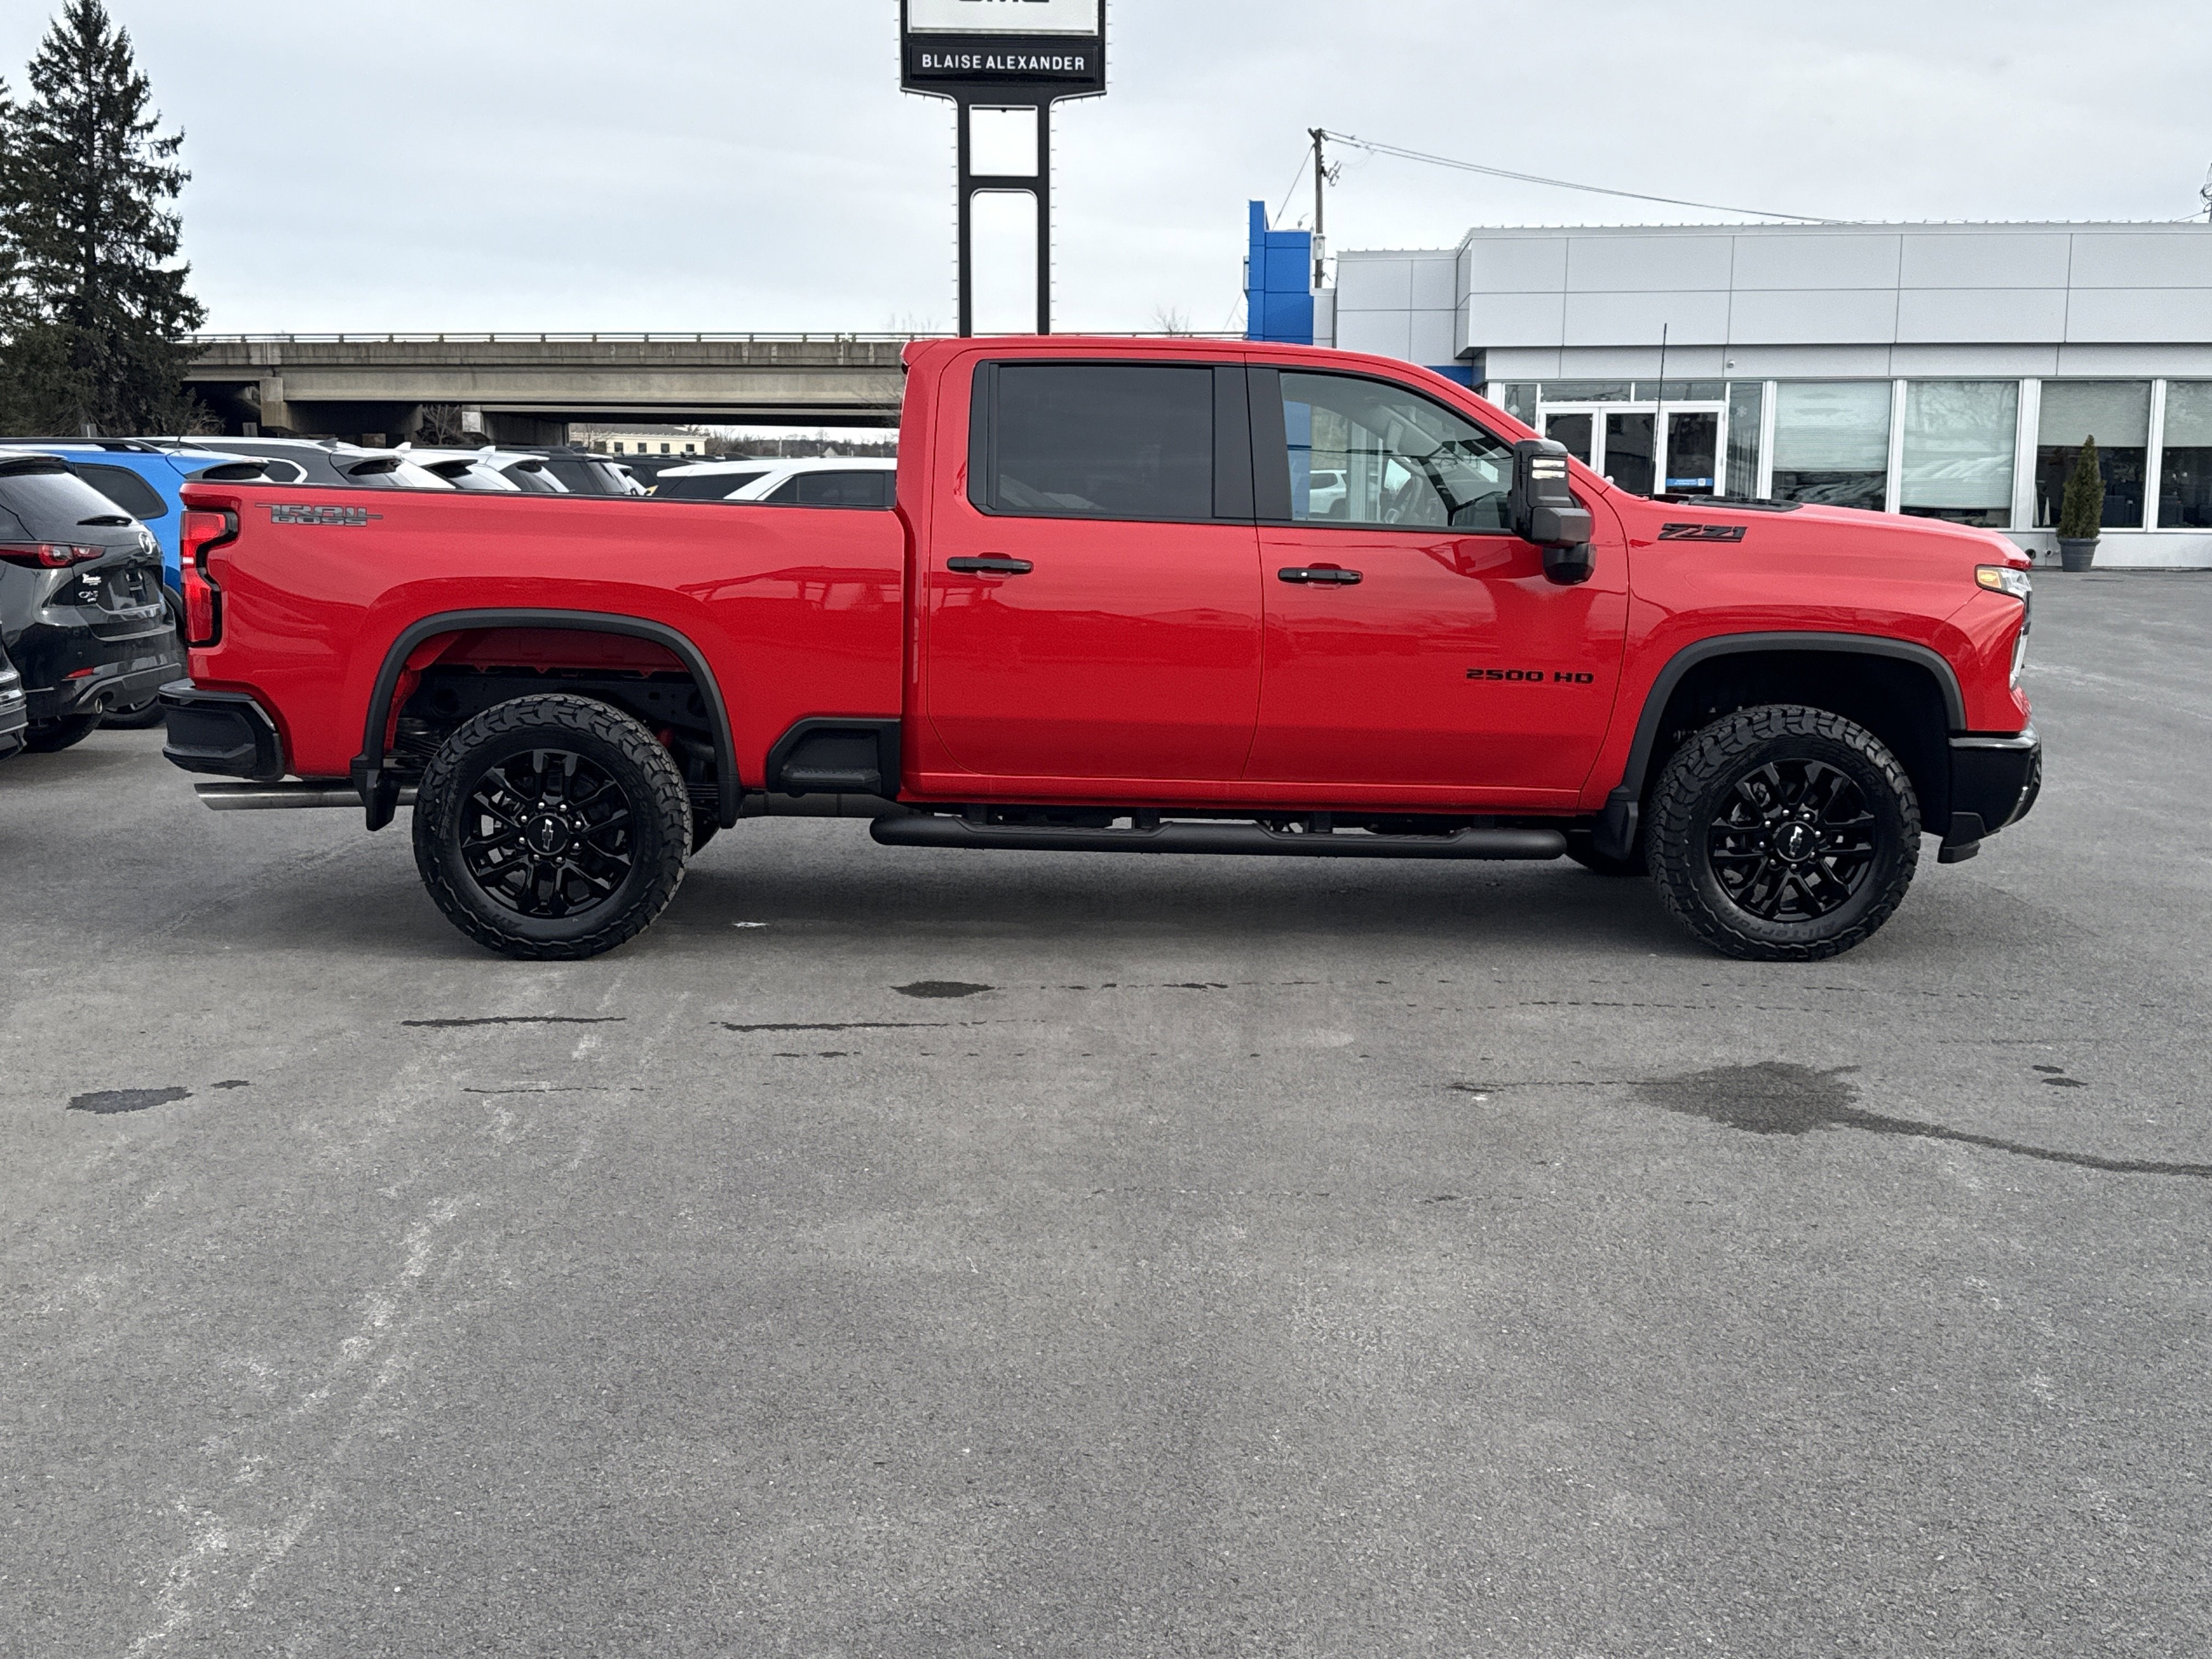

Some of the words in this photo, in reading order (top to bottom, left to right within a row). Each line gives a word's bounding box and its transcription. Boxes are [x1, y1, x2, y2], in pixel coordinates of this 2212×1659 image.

[922, 54, 982, 69] BLAISE
[985, 55, 1085, 71] ALEXANDER
[255, 502, 383, 519] TRAIL
[271, 515, 367, 527] BOSS
[1657, 522, 1748, 543] Z71
[1465, 668, 1544, 682] 2500
[1553, 671, 1594, 684] HD
